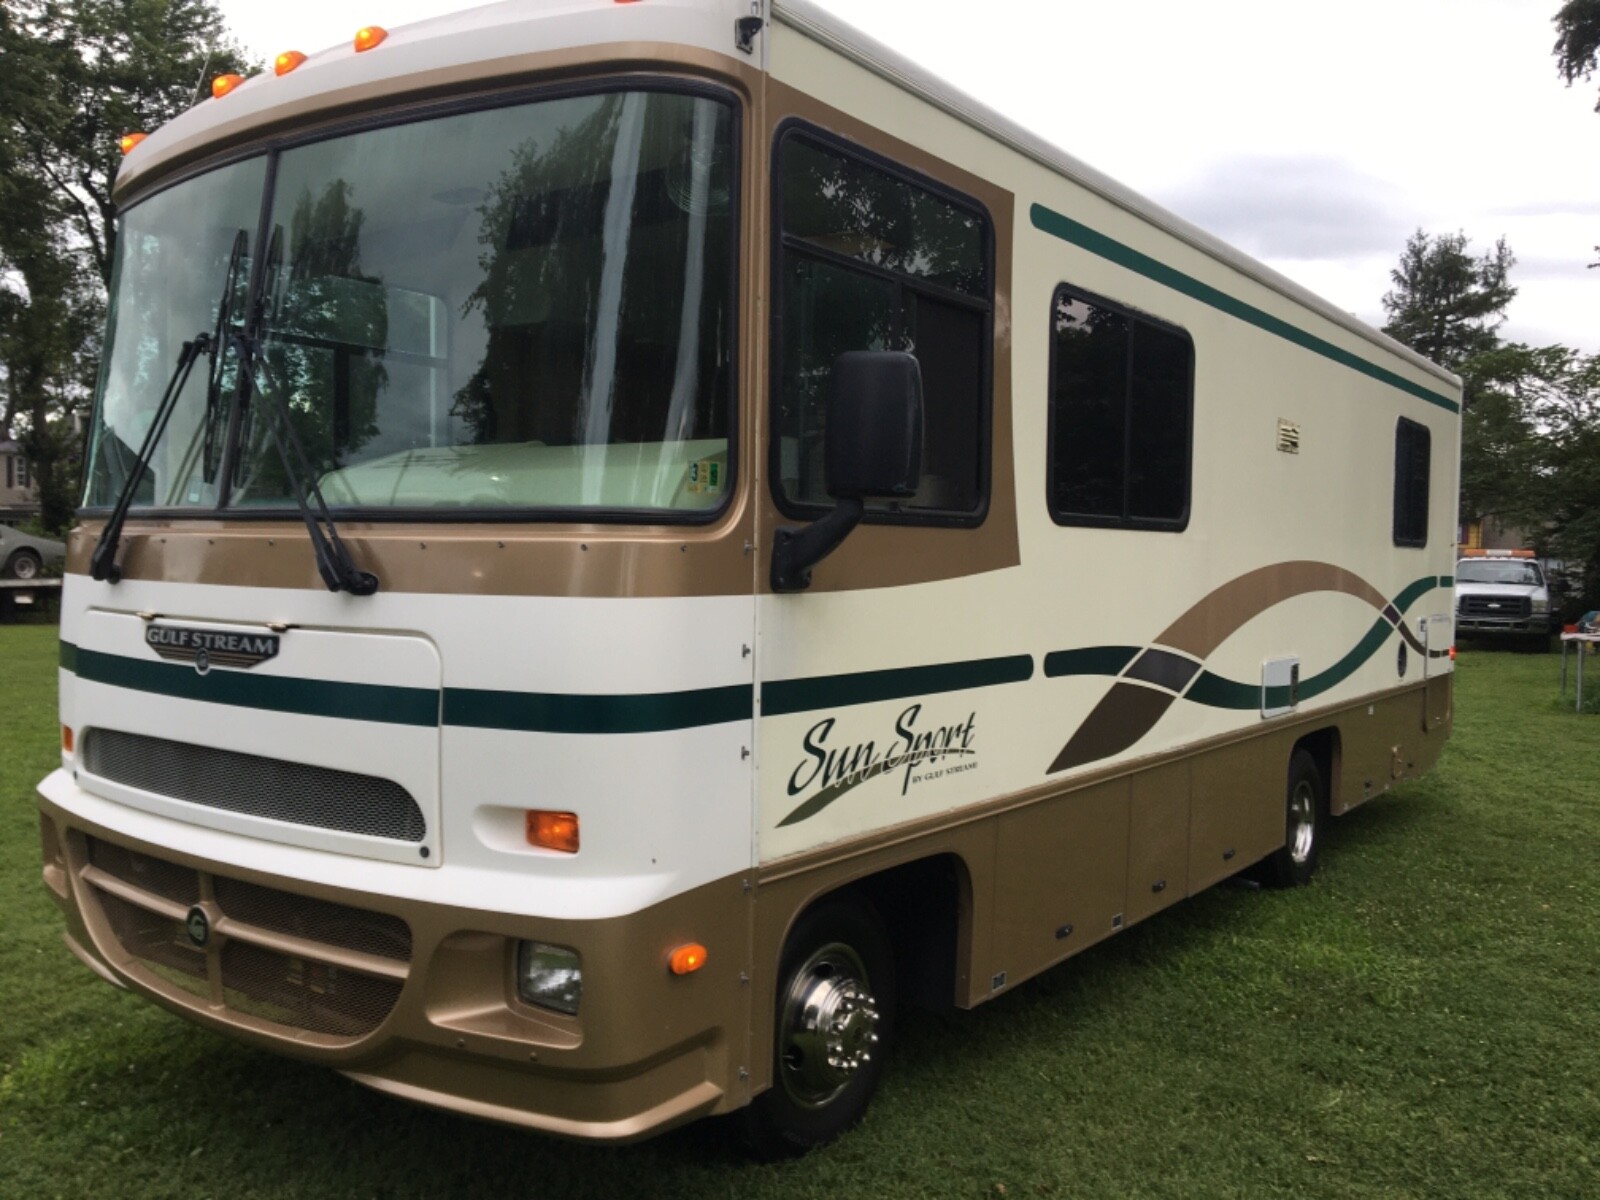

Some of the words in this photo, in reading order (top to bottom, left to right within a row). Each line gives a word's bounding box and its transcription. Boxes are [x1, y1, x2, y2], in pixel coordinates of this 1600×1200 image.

[147, 628, 189, 645] GULF
[191, 632, 274, 655] STREAM
[787, 717, 880, 796] Sun
[883, 703, 976, 796] Sport
[911, 775, 922, 784] BY
[924, 769, 943, 780] GULF
